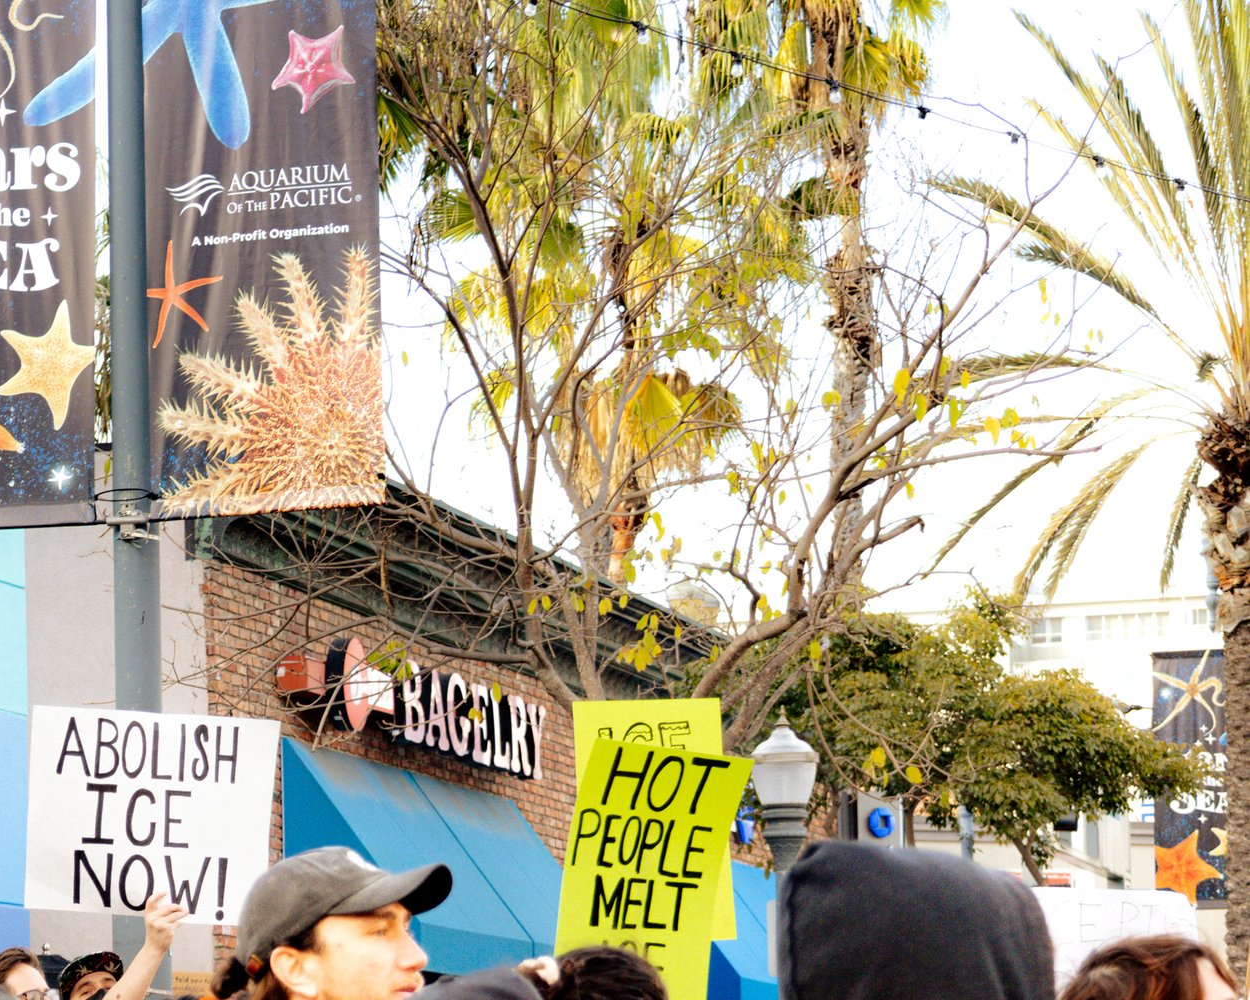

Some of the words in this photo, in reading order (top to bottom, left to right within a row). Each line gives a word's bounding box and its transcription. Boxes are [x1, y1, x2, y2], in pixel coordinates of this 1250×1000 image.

[228, 162, 350, 192] AQUARIUM
[270, 186, 353, 210] PACIFIC
[191, 235, 202, 247] A
[204, 231, 267, 247] Non-Profit
[269, 222, 350, 241] Organization
[56, 716, 239, 784] ABOLISH
[403, 658, 547, 781] BAGELRY
[601, 746, 731, 815] HOT
[81, 782, 192, 849] ICE
[571, 807, 713, 879] PEOPLE
[72, 849, 229, 922] NOW!
[589, 873, 700, 932] MELT
